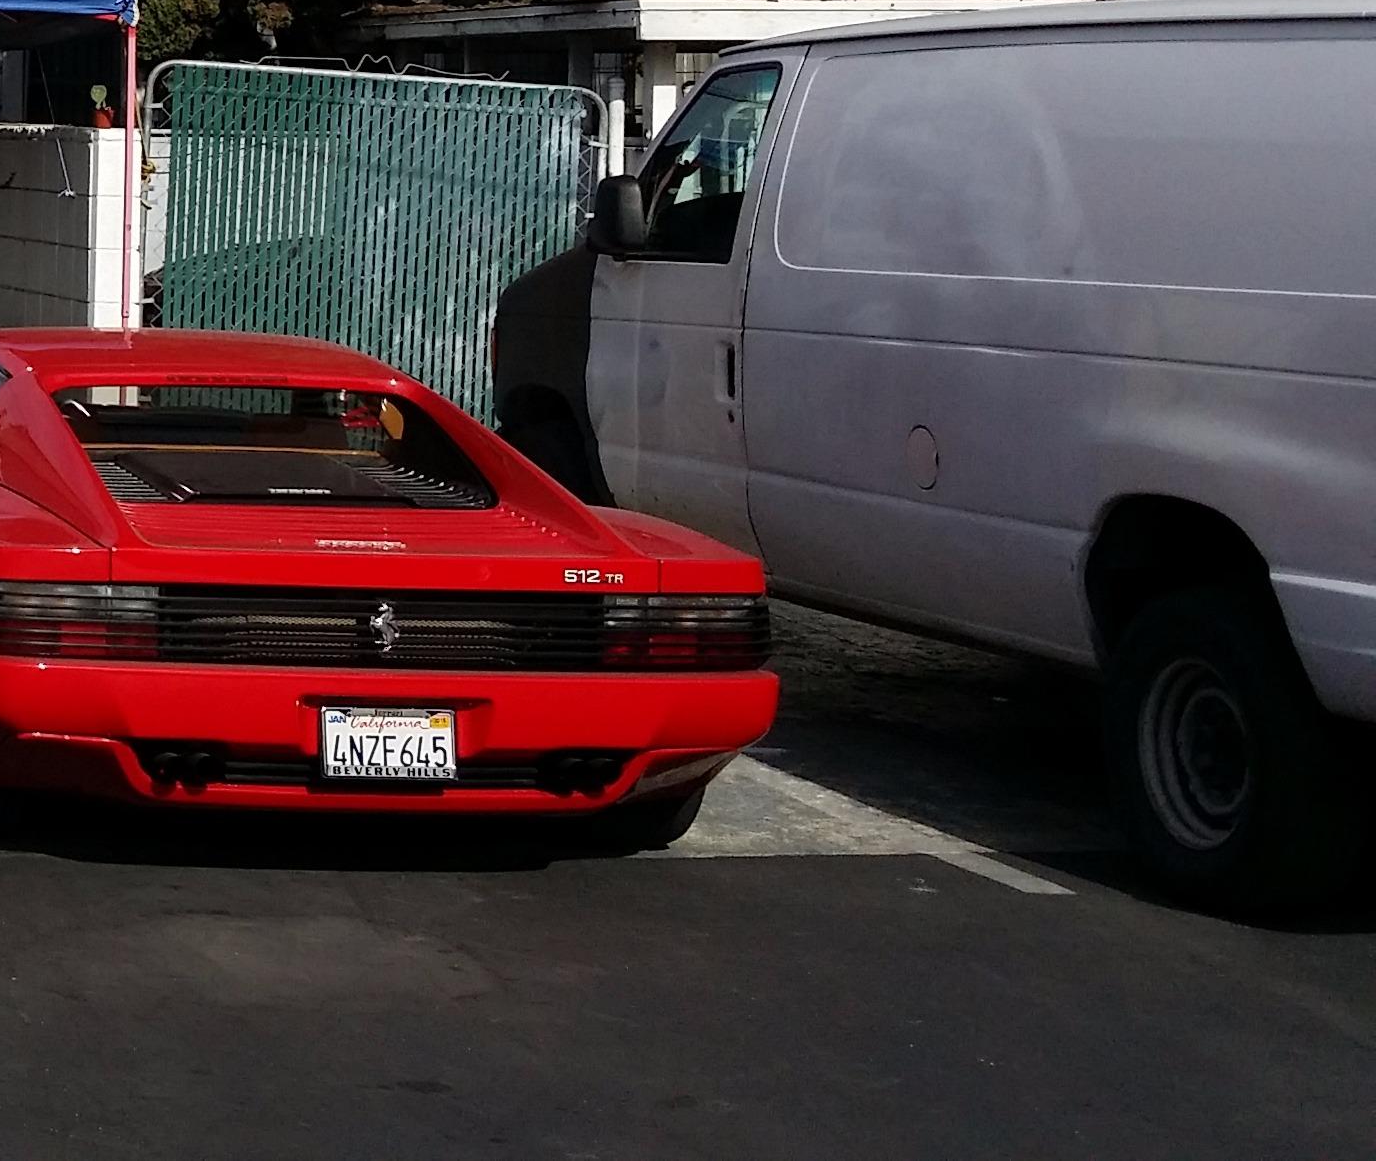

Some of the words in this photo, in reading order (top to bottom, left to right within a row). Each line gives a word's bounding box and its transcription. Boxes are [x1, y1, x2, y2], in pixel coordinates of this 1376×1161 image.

[564, 569, 601, 583] 512
[605, 573, 624, 585] TR
[328, 716, 347, 724] JAN
[350, 715, 429, 733] California
[333, 734, 448, 768] 4NZF645
[333, 765, 401, 776] BEVERLY
[408, 766, 451, 777] HILLS
